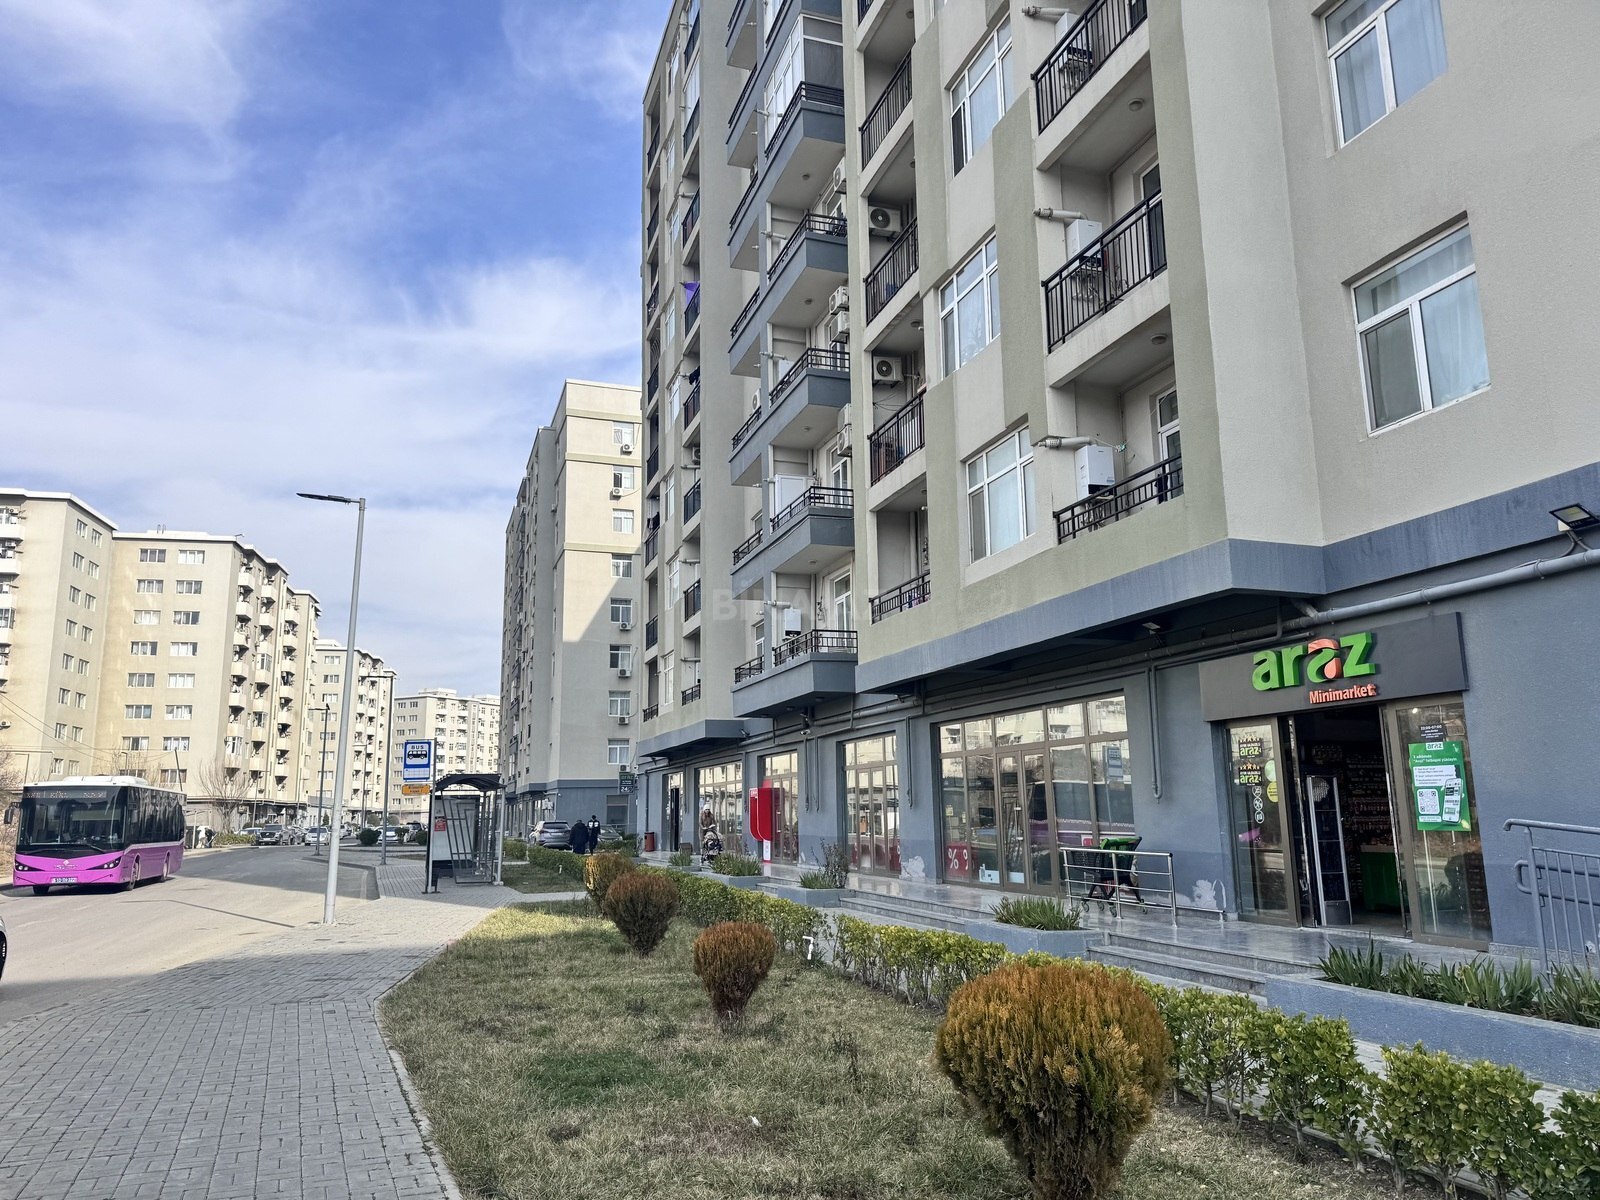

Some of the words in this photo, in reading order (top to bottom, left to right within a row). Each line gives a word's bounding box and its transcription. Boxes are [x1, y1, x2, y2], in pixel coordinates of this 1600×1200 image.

[1252, 631, 1376, 691] araz
[1309, 683, 1377, 704] Minimarket
[1240, 747, 1260, 756] araz
[1240, 775, 1260, 784] araz
